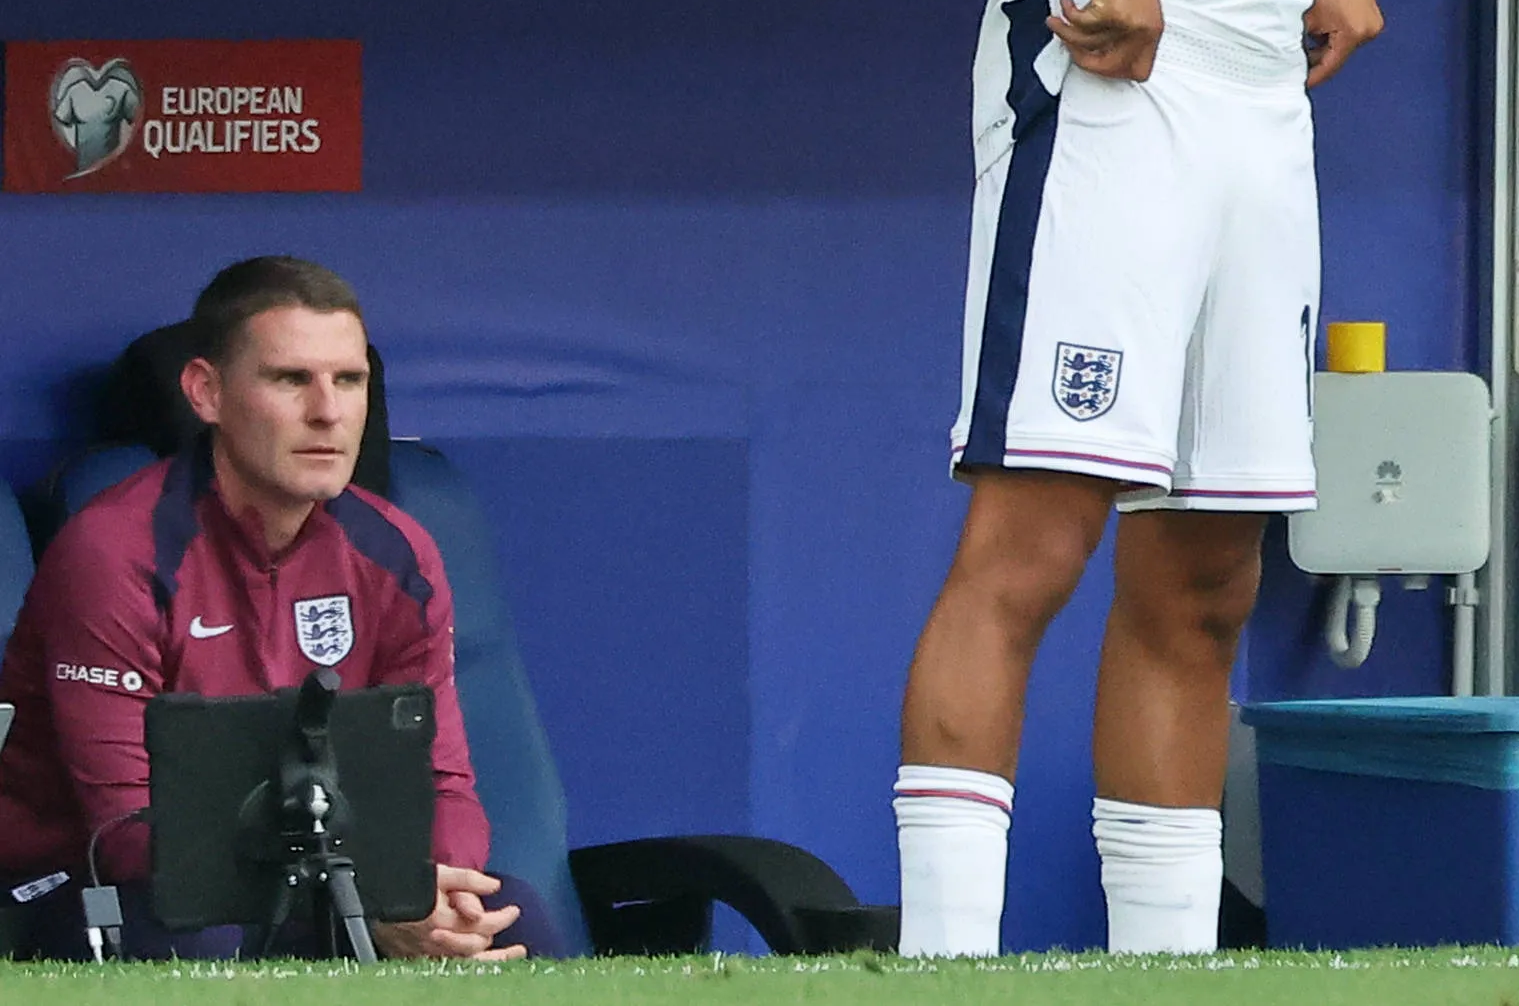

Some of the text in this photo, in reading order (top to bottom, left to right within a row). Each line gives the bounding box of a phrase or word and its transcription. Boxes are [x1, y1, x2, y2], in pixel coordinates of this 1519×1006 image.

[162, 86, 303, 116] EUROPEAN
[143, 119, 321, 159] QUALIFIERS
[56, 663, 120, 687] CHASE
